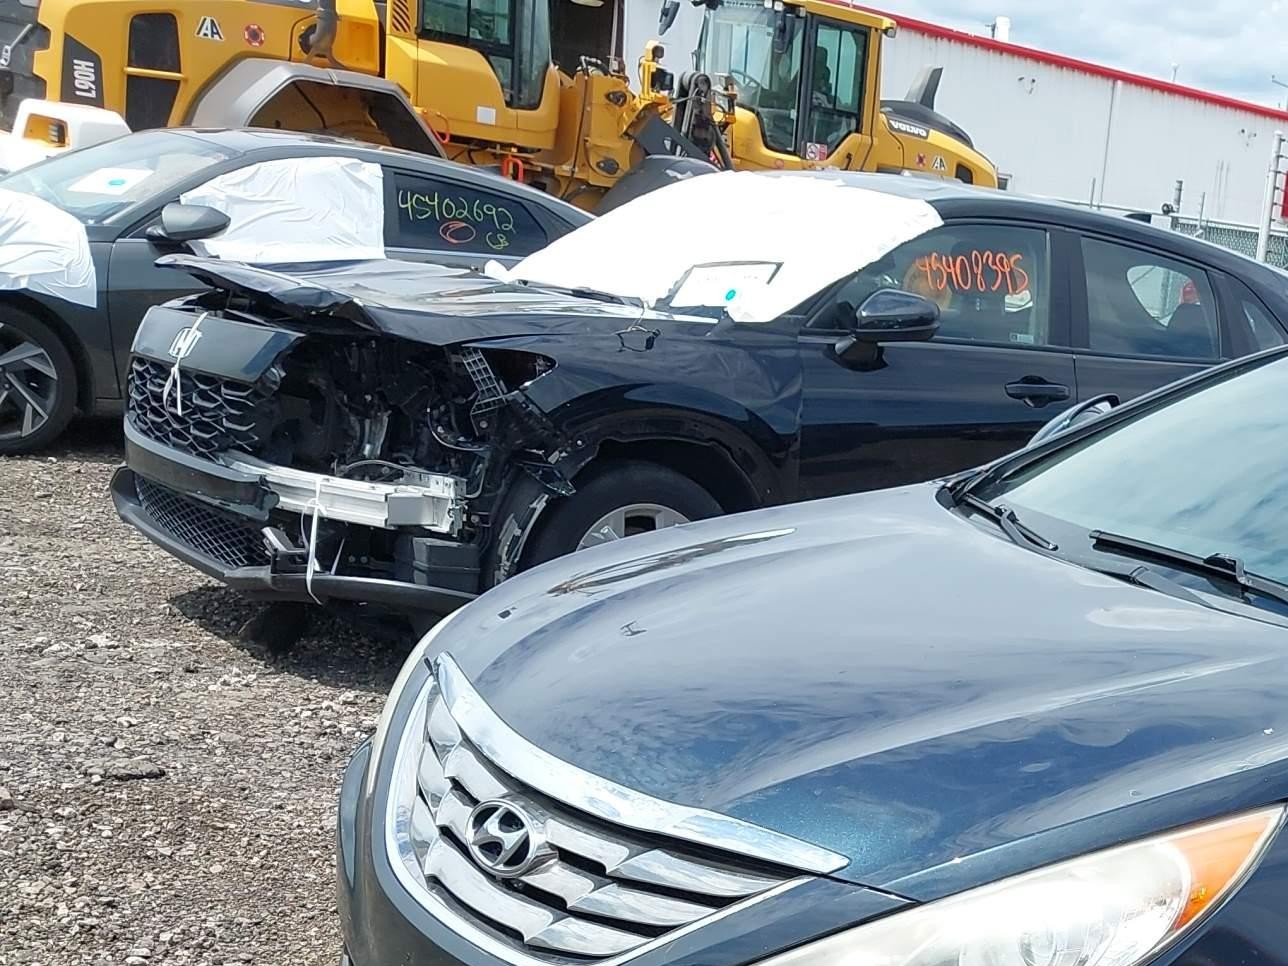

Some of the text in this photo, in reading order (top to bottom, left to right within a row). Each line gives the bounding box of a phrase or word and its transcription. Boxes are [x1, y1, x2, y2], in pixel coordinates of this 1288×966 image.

[73, 59, 96, 98] L90H
[890, 120, 927, 137] VOLVO
[399, 190, 516, 234] 45402692
[915, 250, 1029, 295] 45408395
